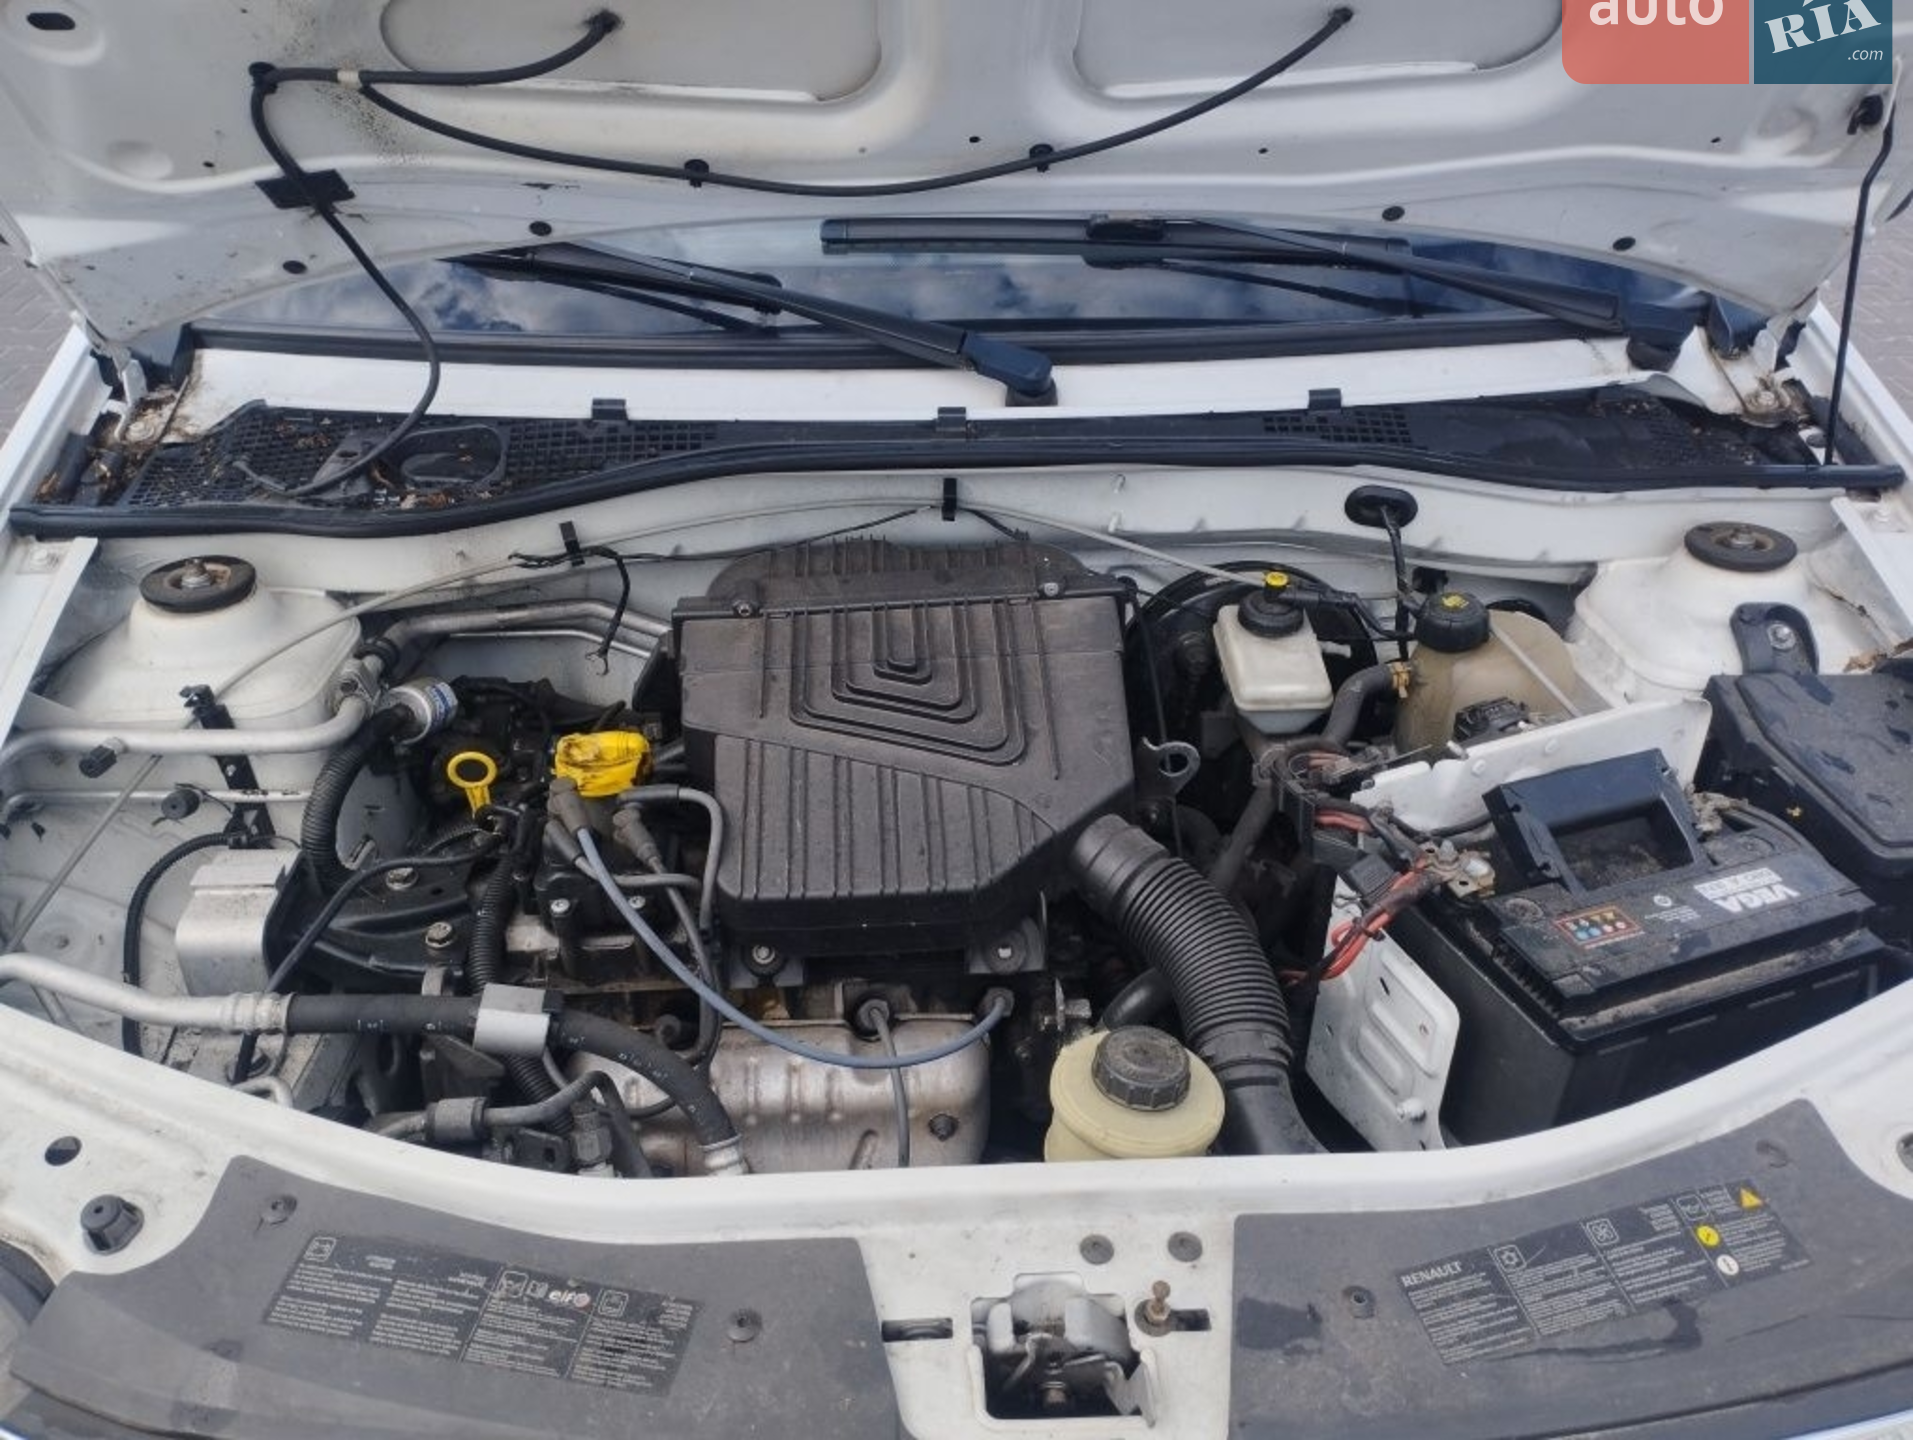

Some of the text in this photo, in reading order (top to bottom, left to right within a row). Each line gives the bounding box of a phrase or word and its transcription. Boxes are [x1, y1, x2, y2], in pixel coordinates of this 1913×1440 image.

[1713, 883, 1800, 914] VEGA
[1401, 1261, 1462, 1287] RENAULT
[549, 1289, 574, 1304] elf
